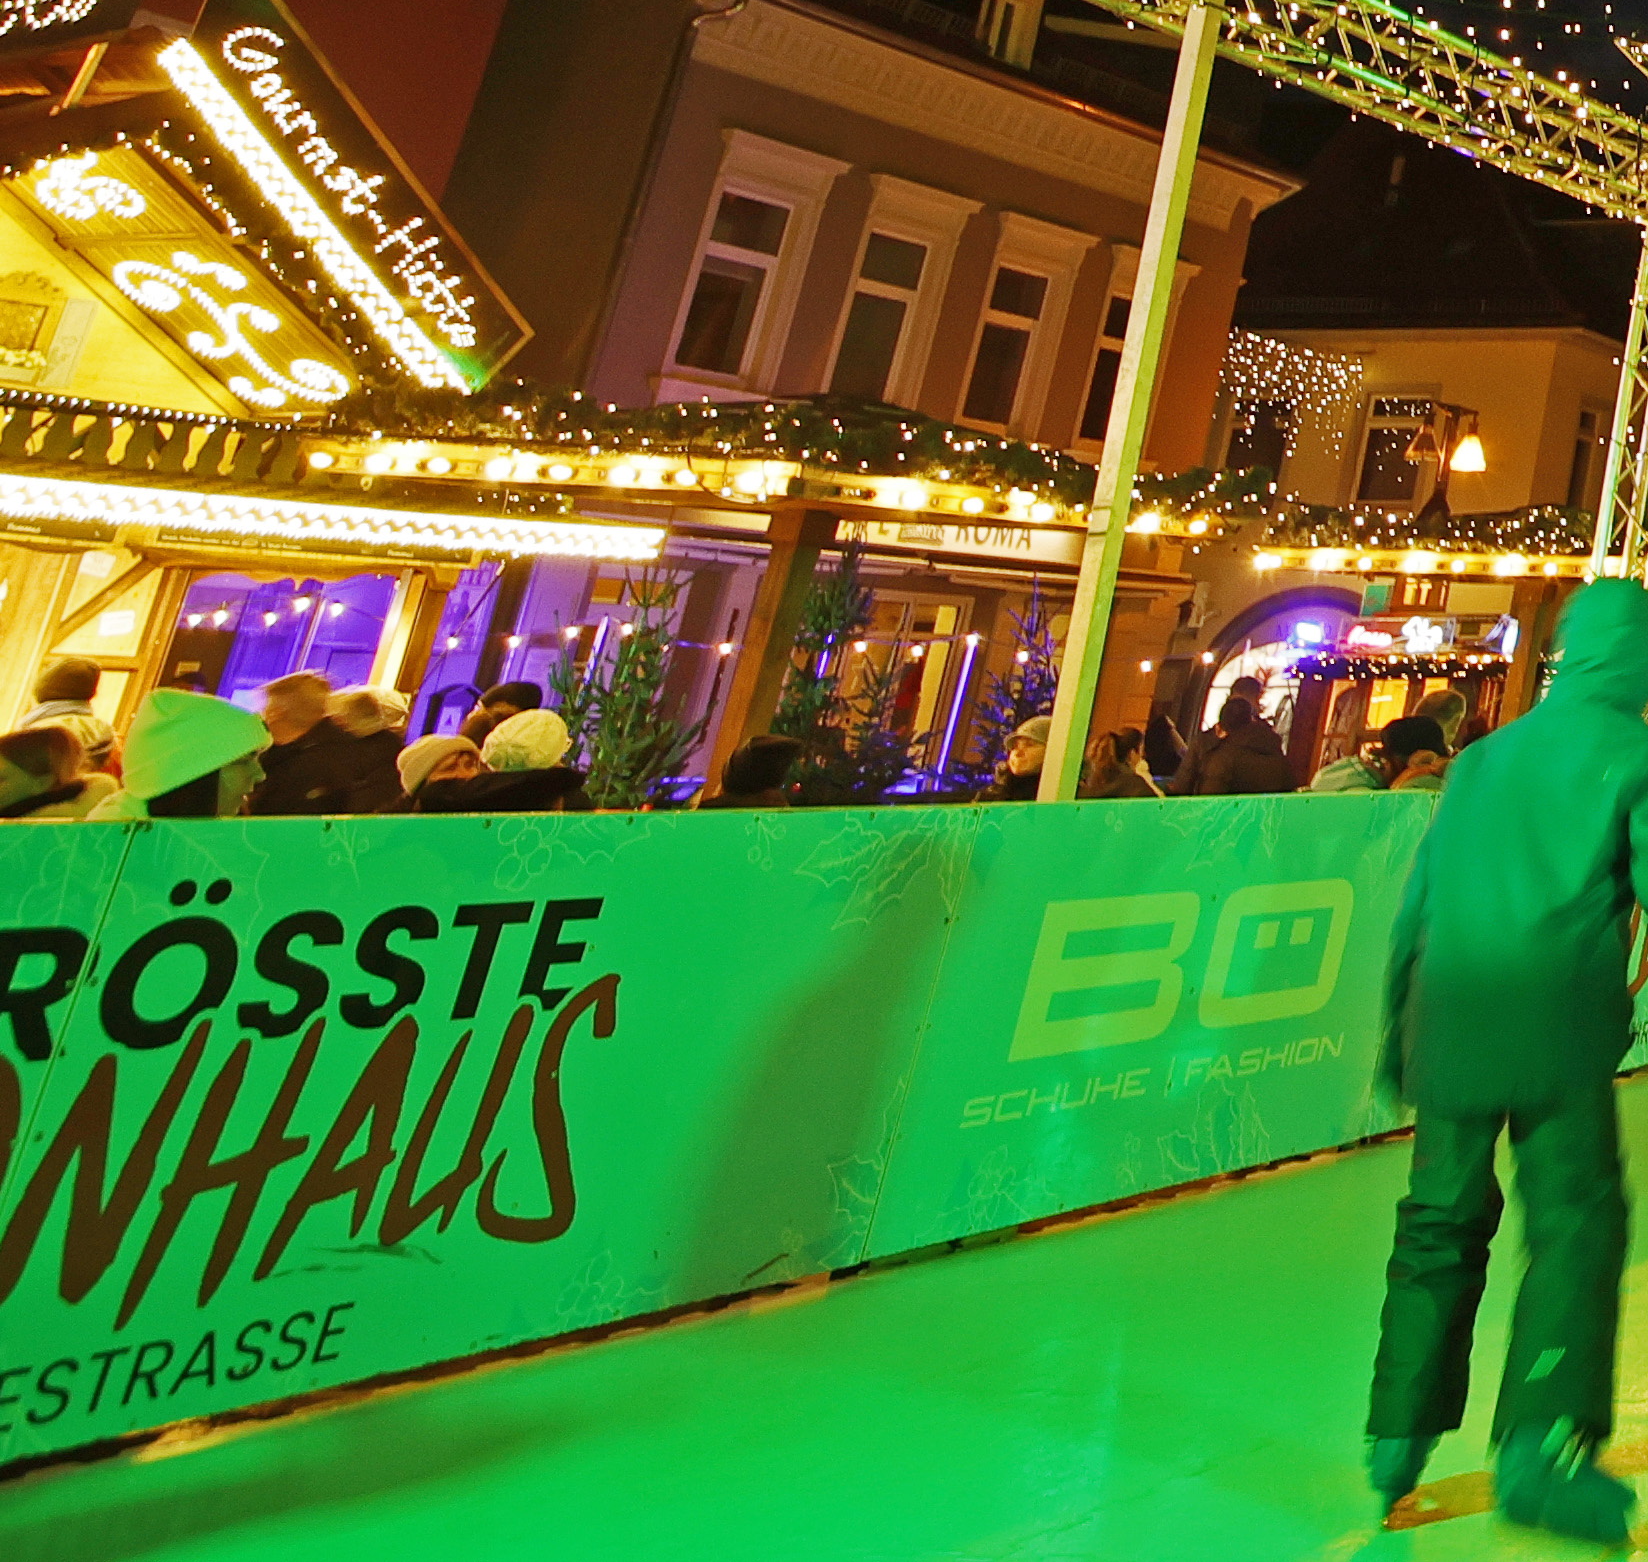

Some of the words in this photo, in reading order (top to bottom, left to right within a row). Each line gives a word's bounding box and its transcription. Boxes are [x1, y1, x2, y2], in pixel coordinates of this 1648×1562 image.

[0, 974, 621, 1332] NHAUS
[959, 1067, 1151, 1129] SCHUHE
[1184, 1032, 1345, 1087] FASHION
